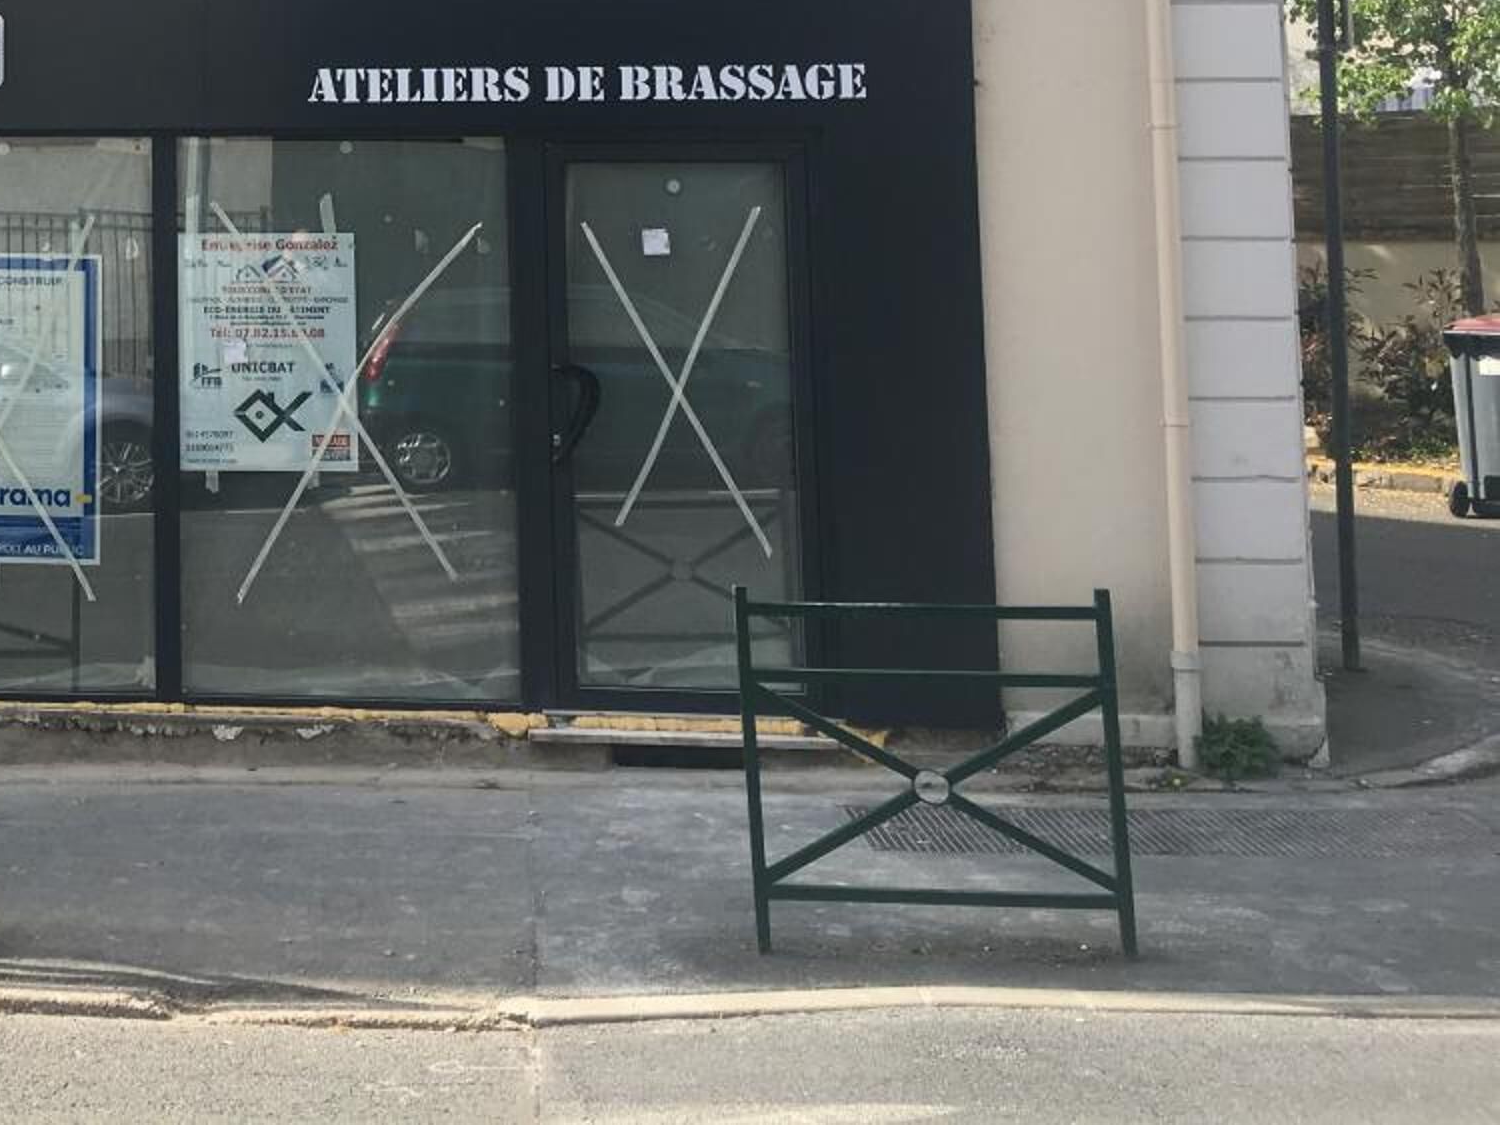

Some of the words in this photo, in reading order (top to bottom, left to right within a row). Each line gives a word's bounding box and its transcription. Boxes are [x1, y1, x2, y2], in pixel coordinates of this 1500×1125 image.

[307, 66, 531, 103] ATELIERS
[544, 66, 605, 103] DE
[619, 63, 868, 102] BRASSAGE
